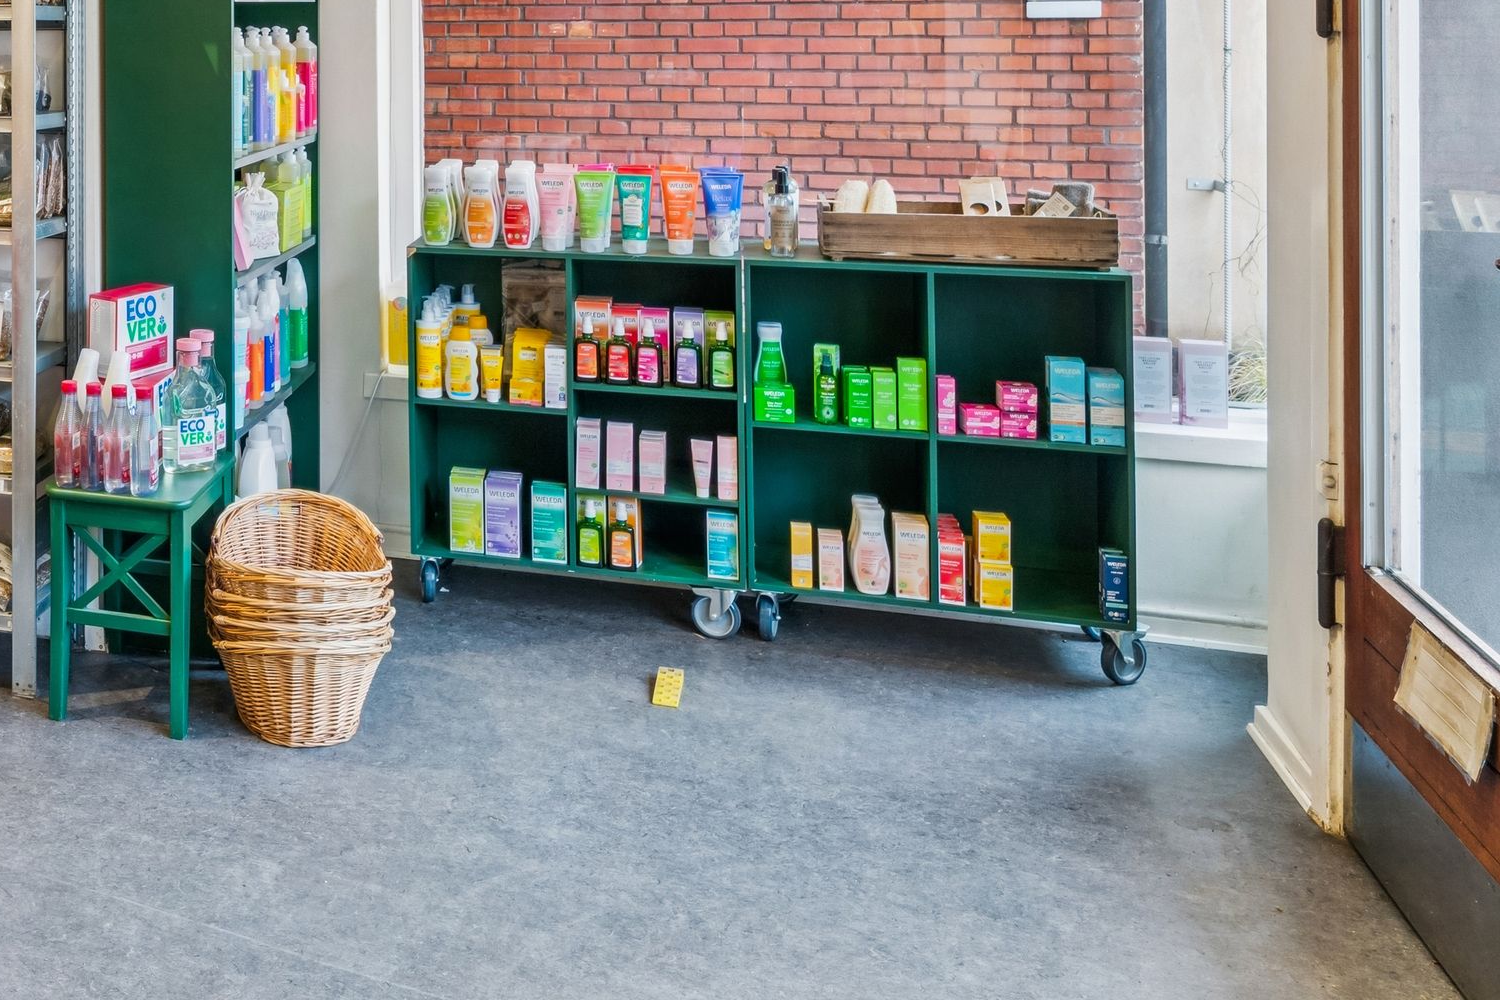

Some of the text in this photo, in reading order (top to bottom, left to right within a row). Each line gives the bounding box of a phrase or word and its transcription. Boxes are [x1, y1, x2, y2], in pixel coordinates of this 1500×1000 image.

[126, 295, 156, 321] ECO
[127, 318, 156, 342] VER
[180, 419, 205, 433] ECO
[180, 433, 205, 445] VER
